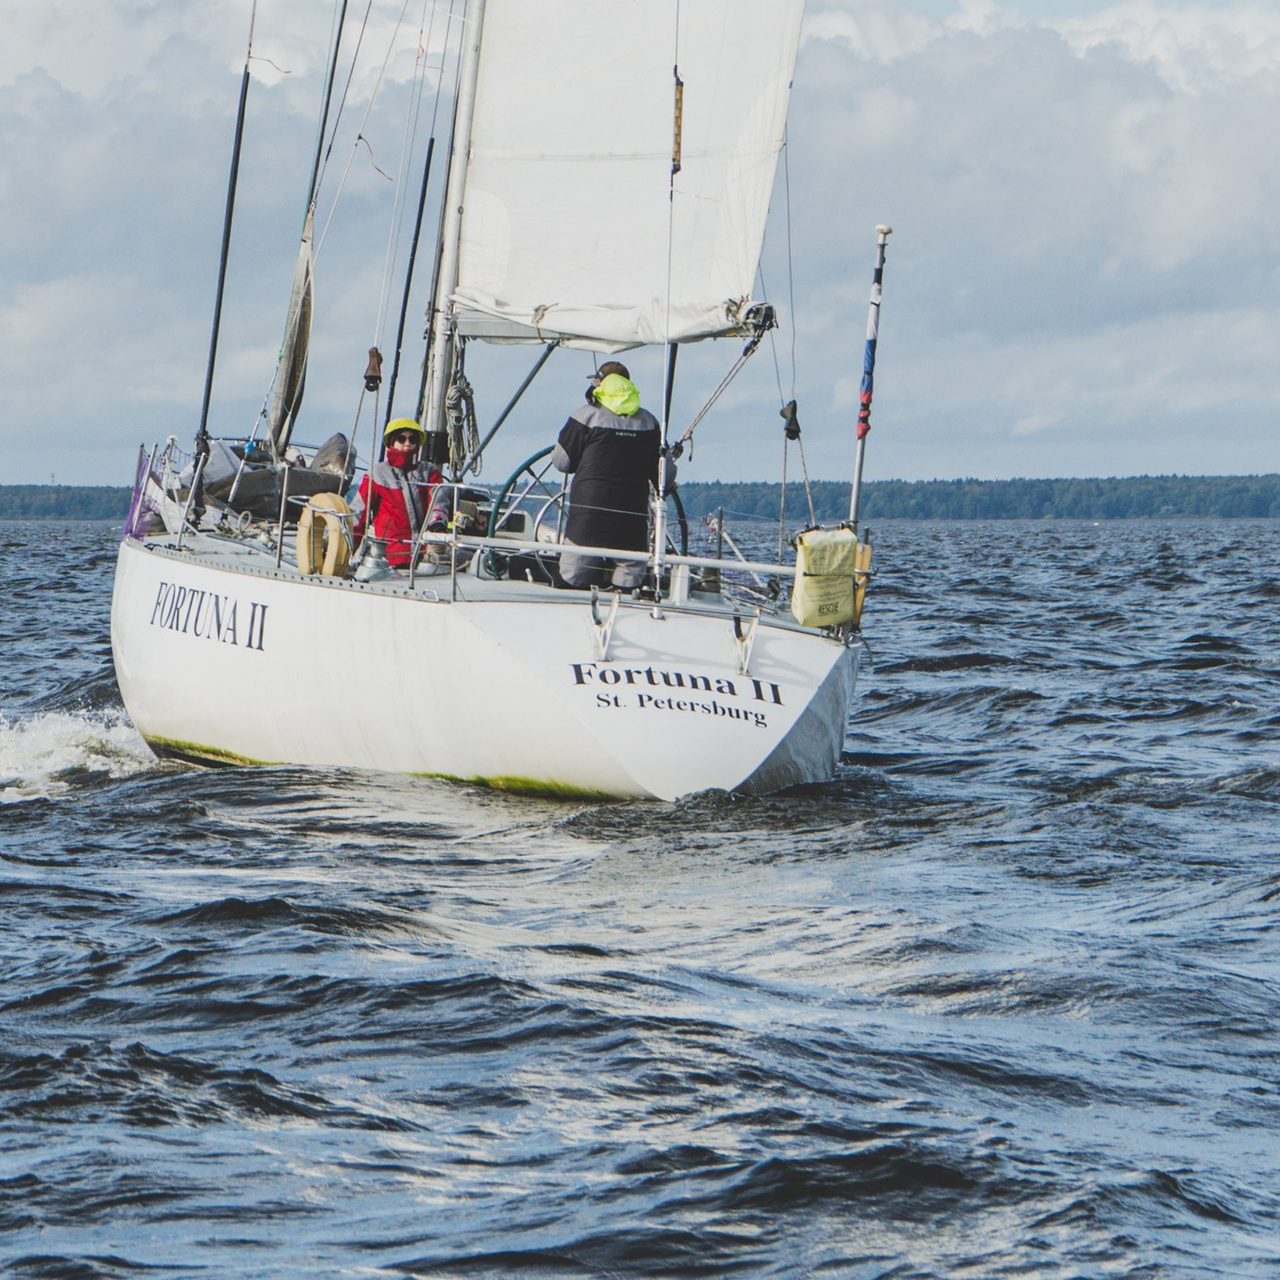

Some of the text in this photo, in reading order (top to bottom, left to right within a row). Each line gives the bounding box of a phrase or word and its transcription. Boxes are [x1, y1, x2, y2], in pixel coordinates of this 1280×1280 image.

[150, 581, 269, 652] FORTUNA II
[568, 662, 787, 706] Fortuna II
[596, 692, 768, 728] St. Petersburg
